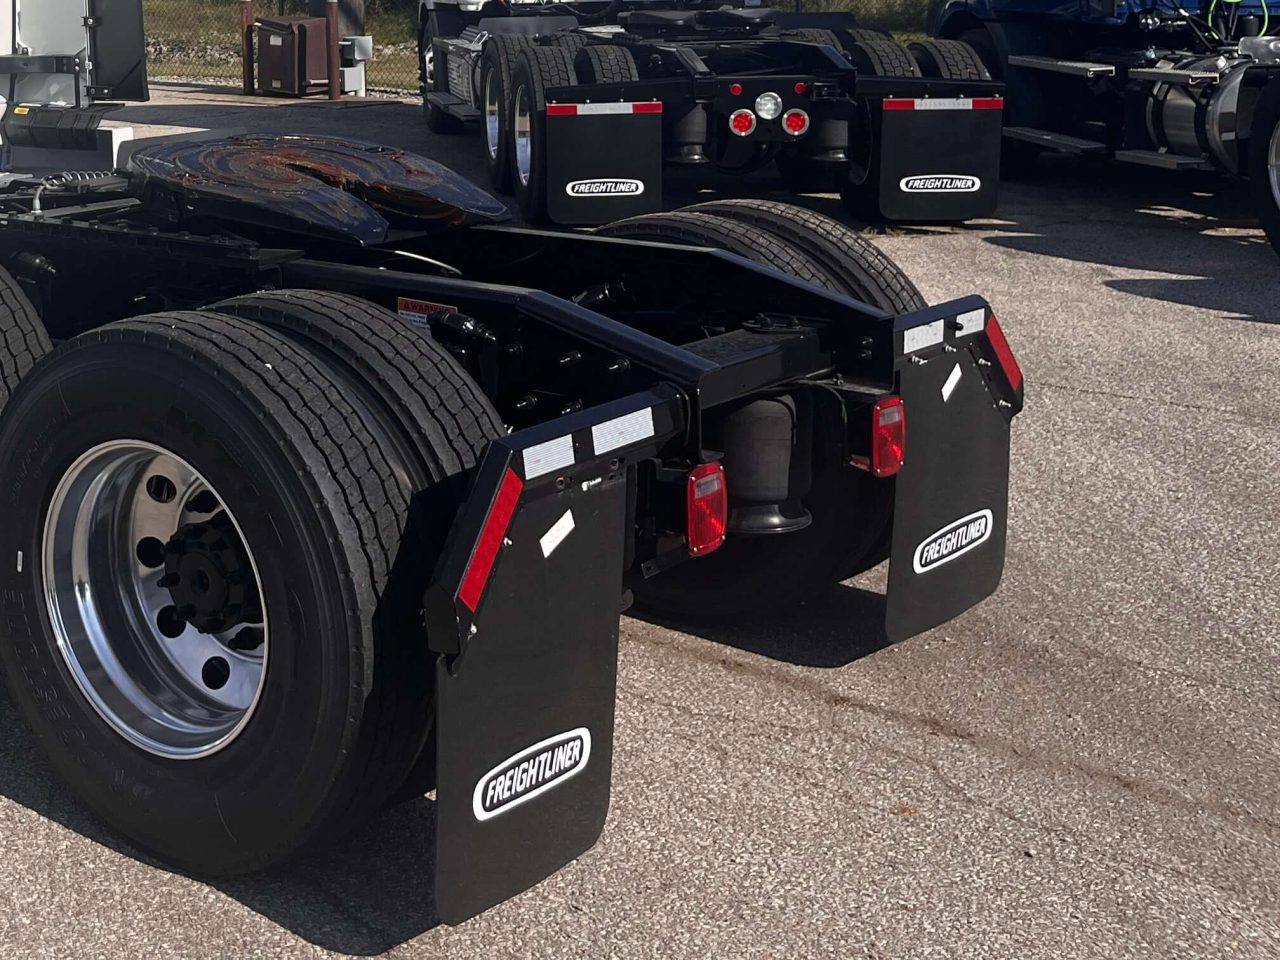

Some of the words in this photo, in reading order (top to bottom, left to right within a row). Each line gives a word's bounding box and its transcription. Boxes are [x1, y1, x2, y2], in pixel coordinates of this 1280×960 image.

[573, 182, 638, 193] FREIGHTLINER
[907, 178, 973, 189] FREIGHTLINER
[921, 517, 987, 565] FREIGHTLINER
[485, 738, 582, 808] FREIGHTLINER
